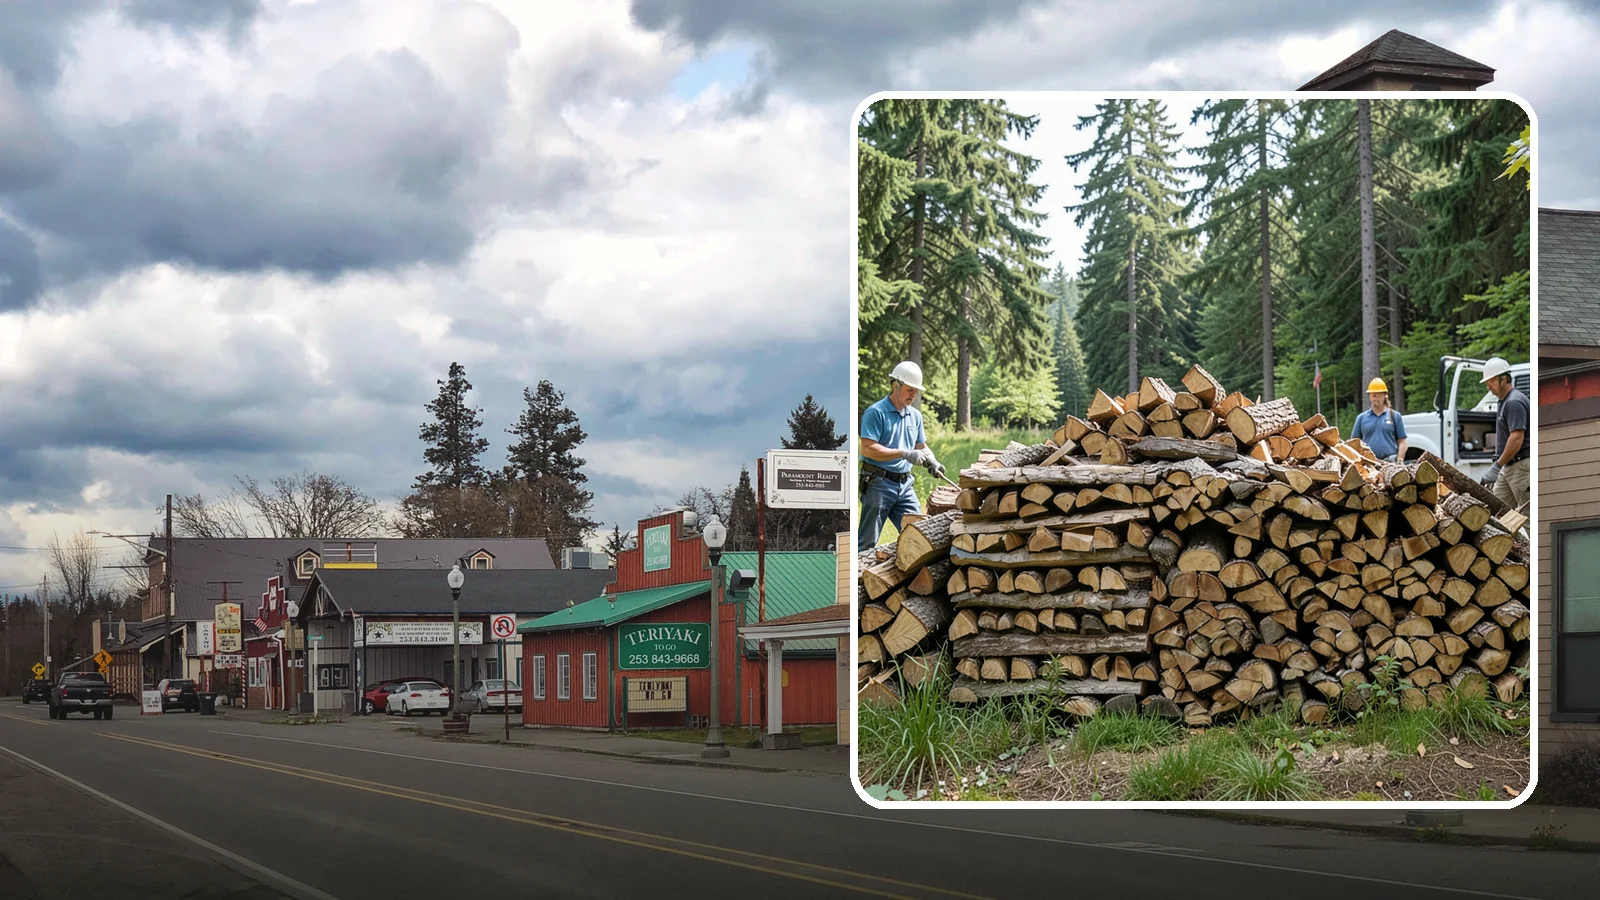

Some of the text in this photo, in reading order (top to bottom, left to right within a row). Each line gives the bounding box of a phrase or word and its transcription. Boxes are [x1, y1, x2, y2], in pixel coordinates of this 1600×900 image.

[817, 472, 839, 480] REALTY
[646, 531, 668, 549] TERIYAKI
[625, 627, 702, 646] TERIYAKI
[629, 653, 700, 665] 253 843-9668
[639, 681, 673, 690] TERIYAKI
